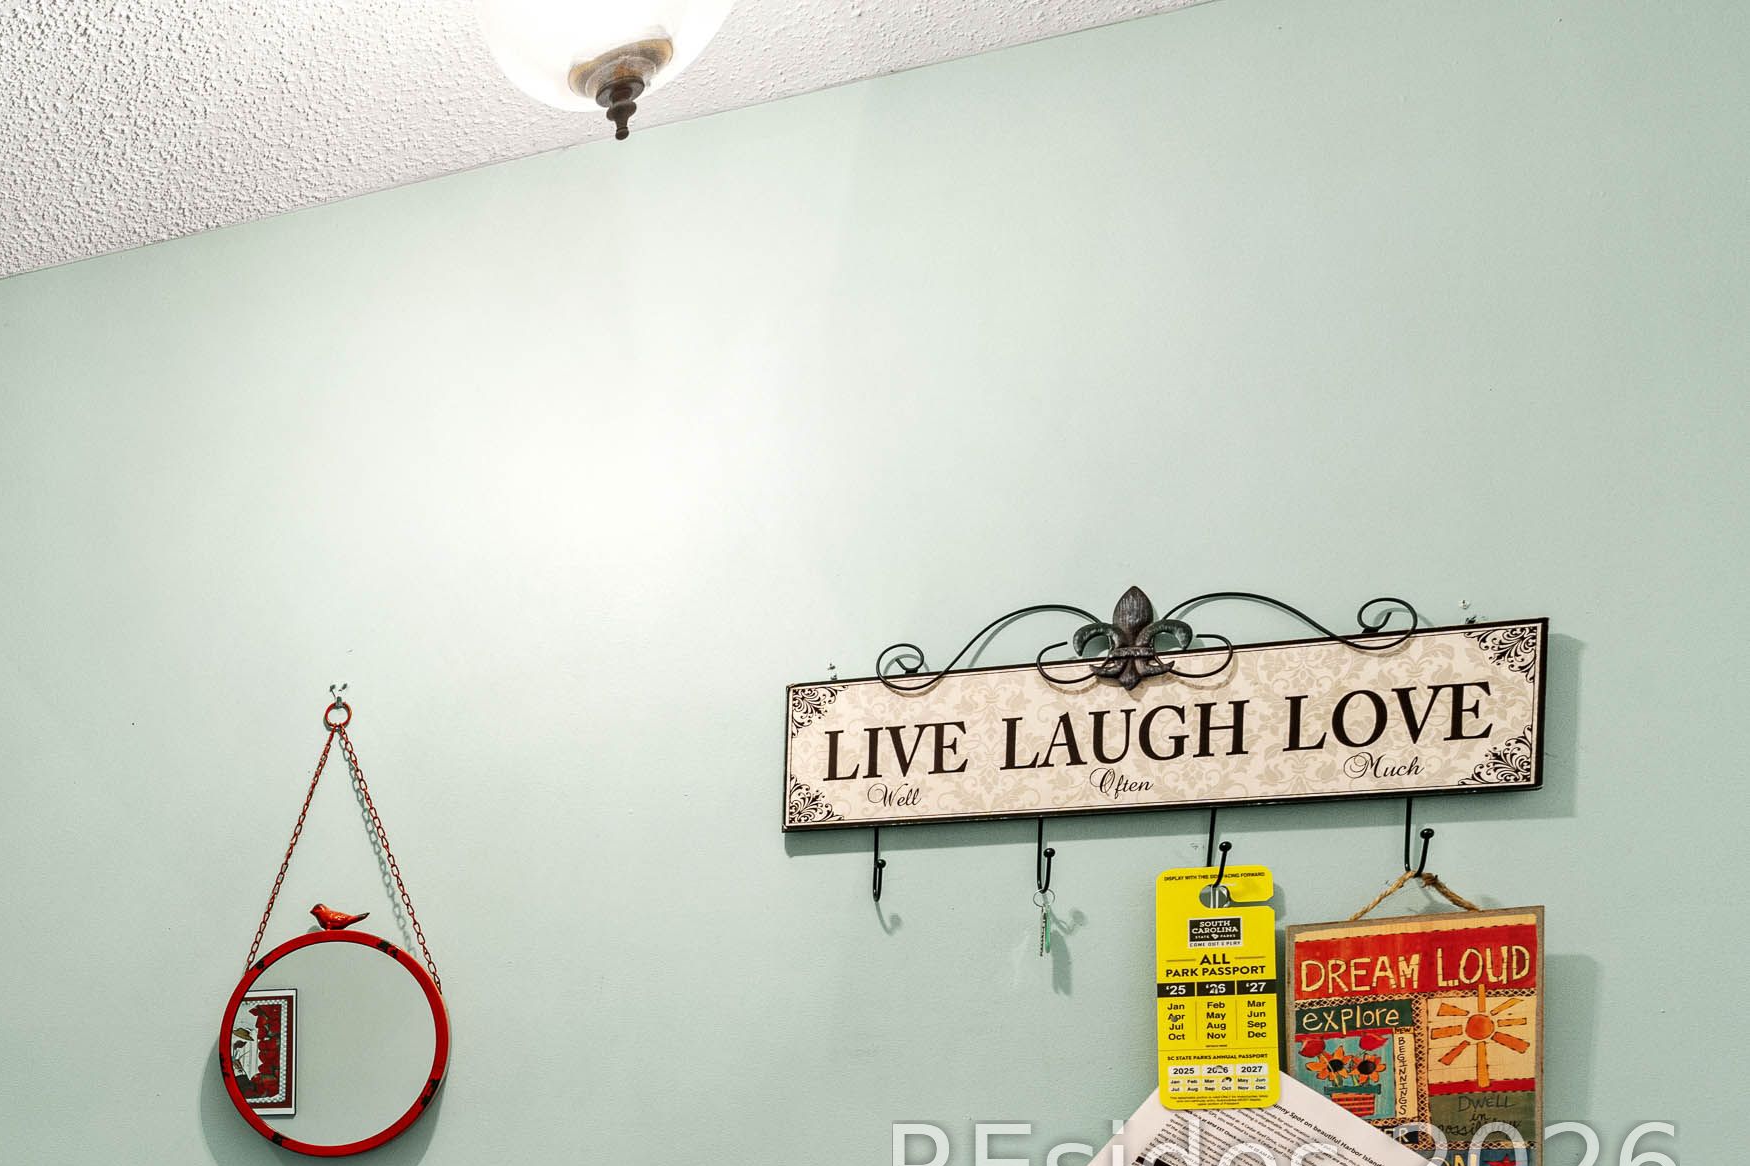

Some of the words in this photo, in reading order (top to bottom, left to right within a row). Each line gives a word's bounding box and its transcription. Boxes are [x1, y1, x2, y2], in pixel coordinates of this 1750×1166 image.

[822, 720, 968, 782] LIVE
[999, 699, 1249, 772] LAUGH
[1283, 680, 1494, 753] LOVE
[1343, 750, 1424, 781] Much
[1089, 766, 1154, 798] Often
[867, 781, 923, 809] Well
[1192, 926, 1238, 934] CAROLINA
[1200, 920, 1230, 928] SOUTH
[1200, 954, 1230, 966] ALL
[1166, 968, 1198, 978] PARK
[1202, 966, 1266, 976] PASSPORT
[1301, 954, 1420, 993] DREAM
[1437, 945, 1530, 987] LOUD
[1247, 1000, 1266, 1008] Mar
[1206, 1012, 1226, 1020] May
[1247, 1010, 1266, 1018] Jun
[1302, 1006, 1400, 1035] explore
[1206, 1022, 1226, 1030] Aug
[1247, 1020, 1266, 1029] Sep
[1207, 1032, 1226, 1040] Nov
[1247, 1030, 1266, 1038] Dec
[1396, 1036, 1408, 1116] BEGINNINGS
[1470, 1113, 1491, 1122] in
[1271, 1102, 1290, 1115] unny
[1288, 1111, 1304, 1123] Spot
[1303, 1120, 1313, 1128] on
[1312, 1125, 1341, 1144] beautiful
[1339, 1141, 1363, 1157] Harbor
